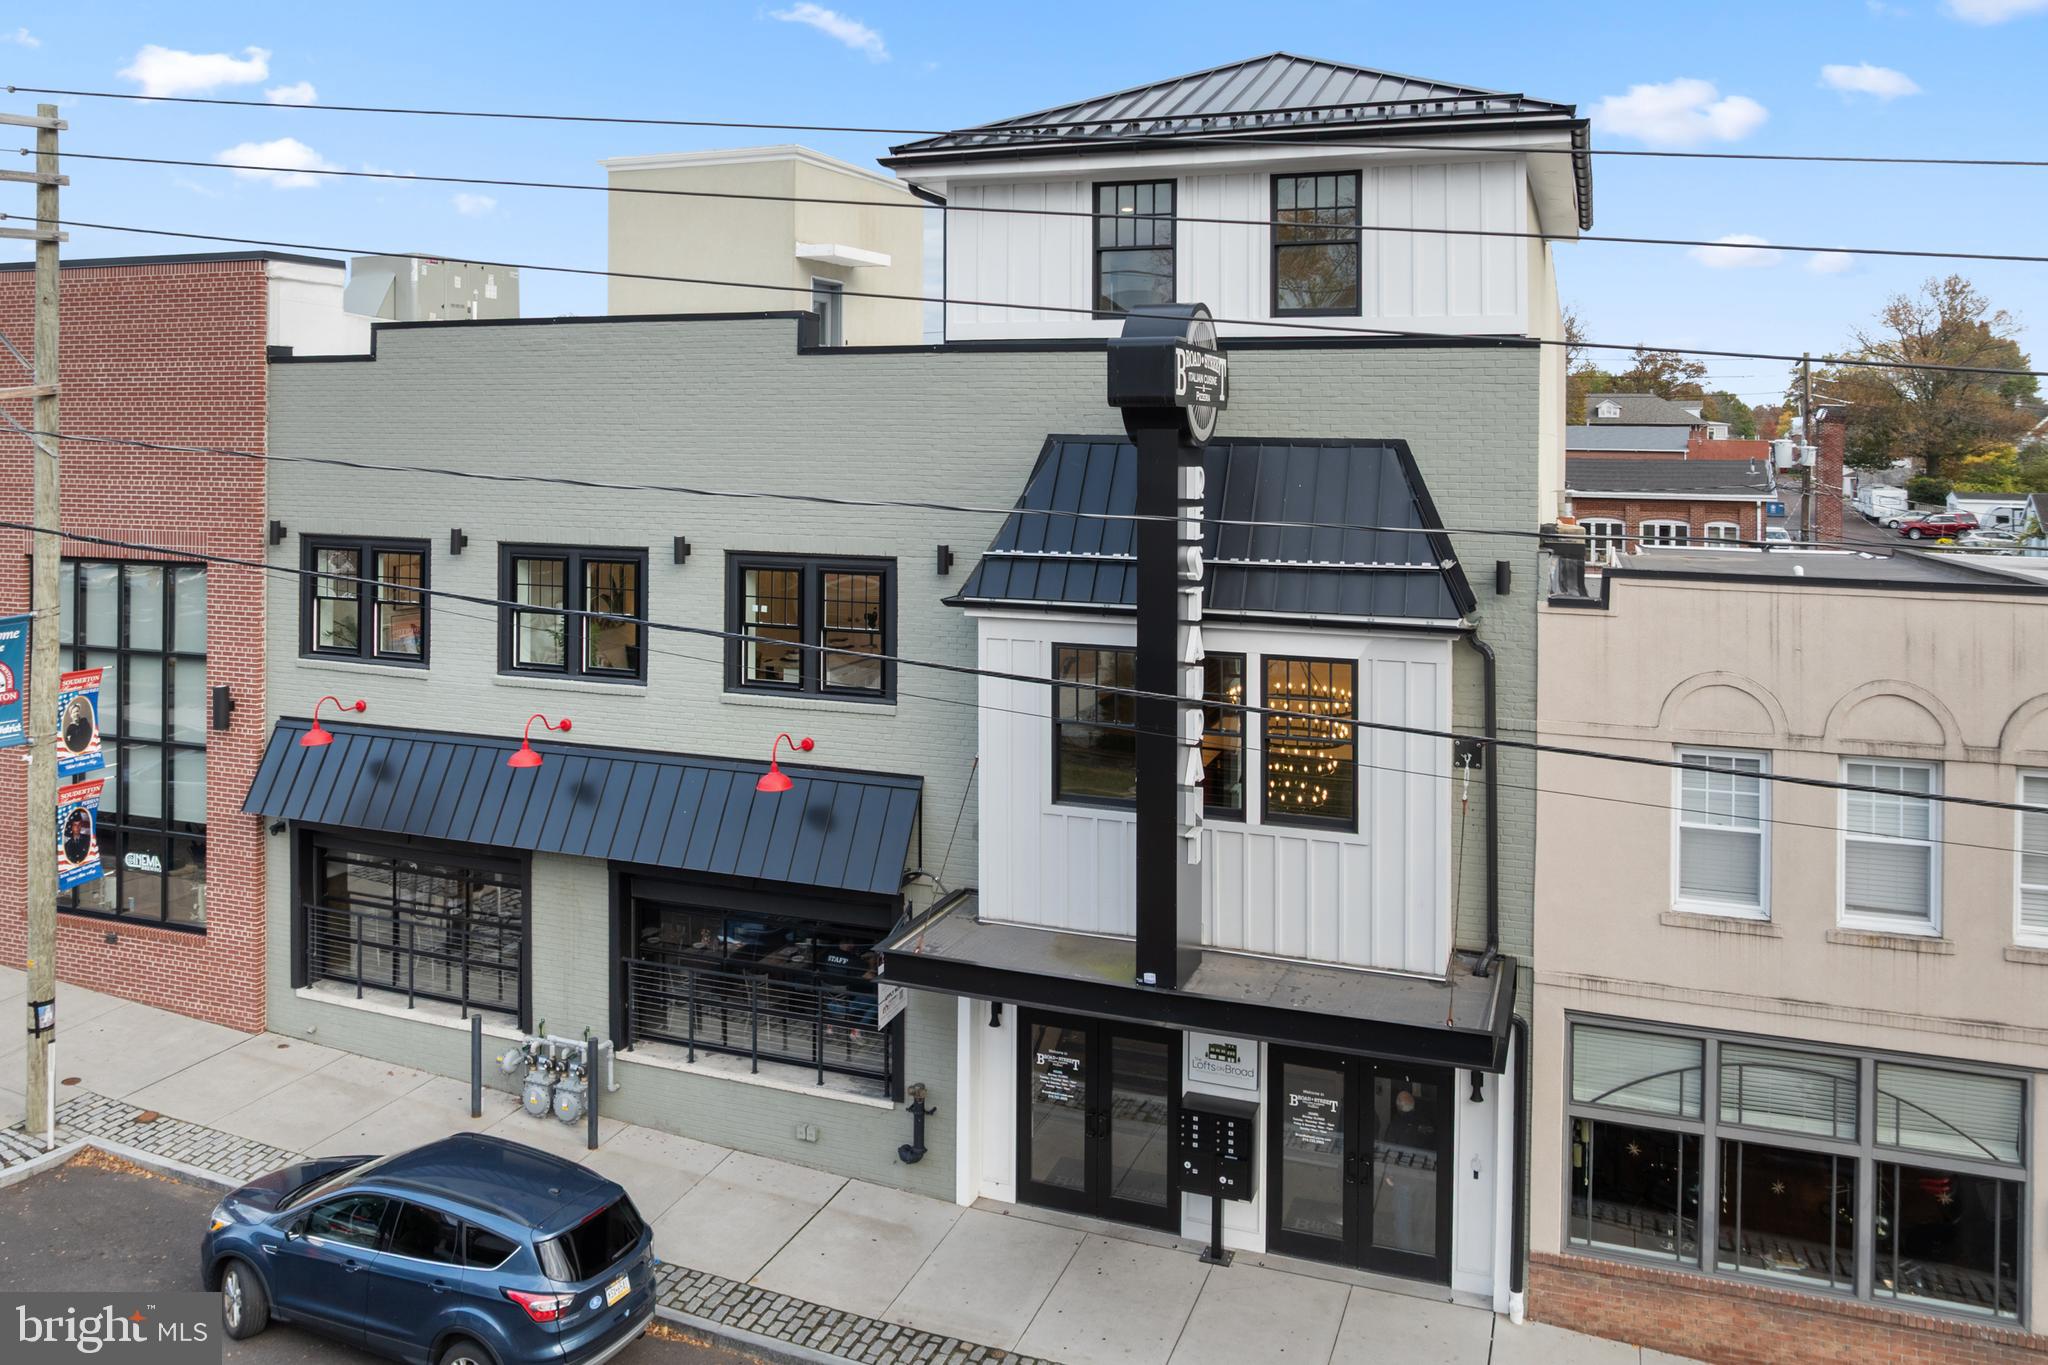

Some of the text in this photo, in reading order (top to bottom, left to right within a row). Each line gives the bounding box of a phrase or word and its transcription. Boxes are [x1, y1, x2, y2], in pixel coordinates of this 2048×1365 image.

[62, 674, 101, 687] SOUDERTON
[60, 785, 102, 799] SOUDERTON
[1192, 1058, 1216, 1072] Lofts
[1225, 1064, 1255, 1078] Broad
